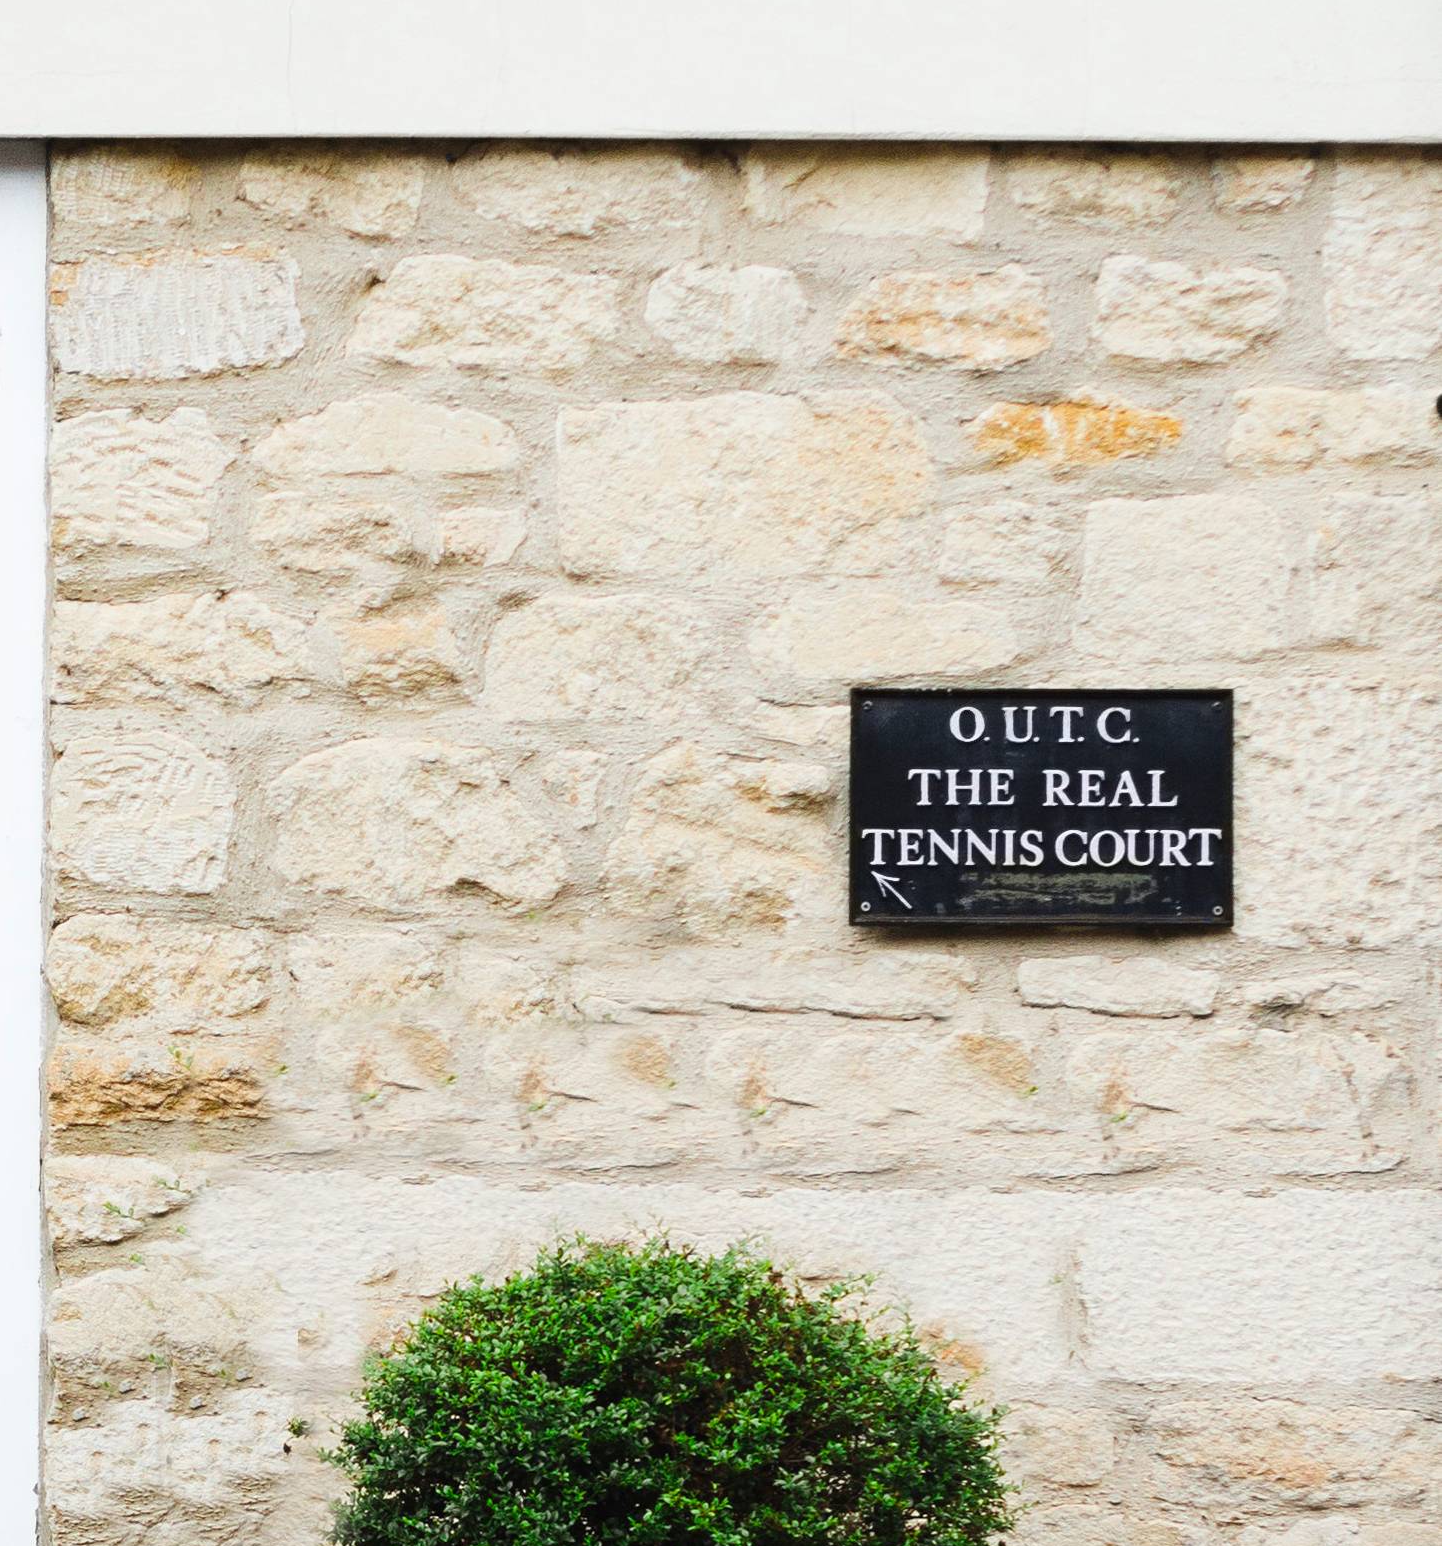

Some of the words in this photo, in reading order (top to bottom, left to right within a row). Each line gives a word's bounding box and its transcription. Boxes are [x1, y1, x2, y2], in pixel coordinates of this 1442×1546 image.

[908, 768, 1015, 806] THE
[1042, 769, 1179, 807] REAL
[861, 828, 1044, 867] TENNIS
[1054, 828, 1222, 867] COURT
